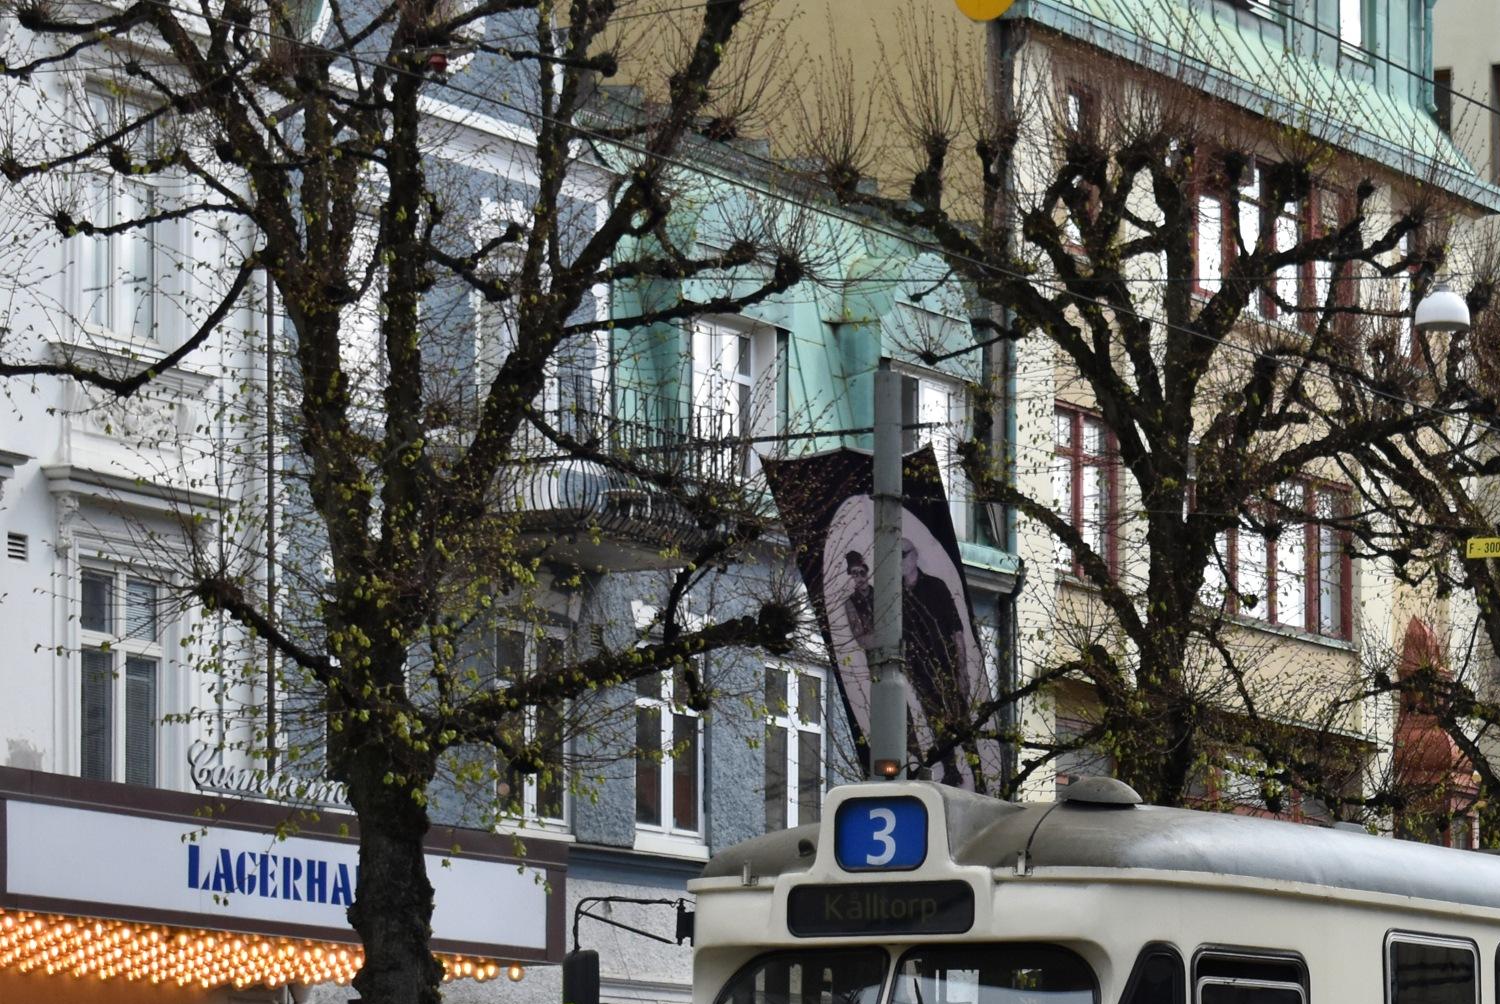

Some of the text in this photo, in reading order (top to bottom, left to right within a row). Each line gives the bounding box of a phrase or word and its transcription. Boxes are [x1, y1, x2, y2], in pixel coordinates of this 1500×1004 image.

[1469, 543, 1475, 555] F
[866, 807, 897, 866] 3
[187, 844, 360, 907] LAGERHA
[824, 891, 938, 923] Kålltorp
